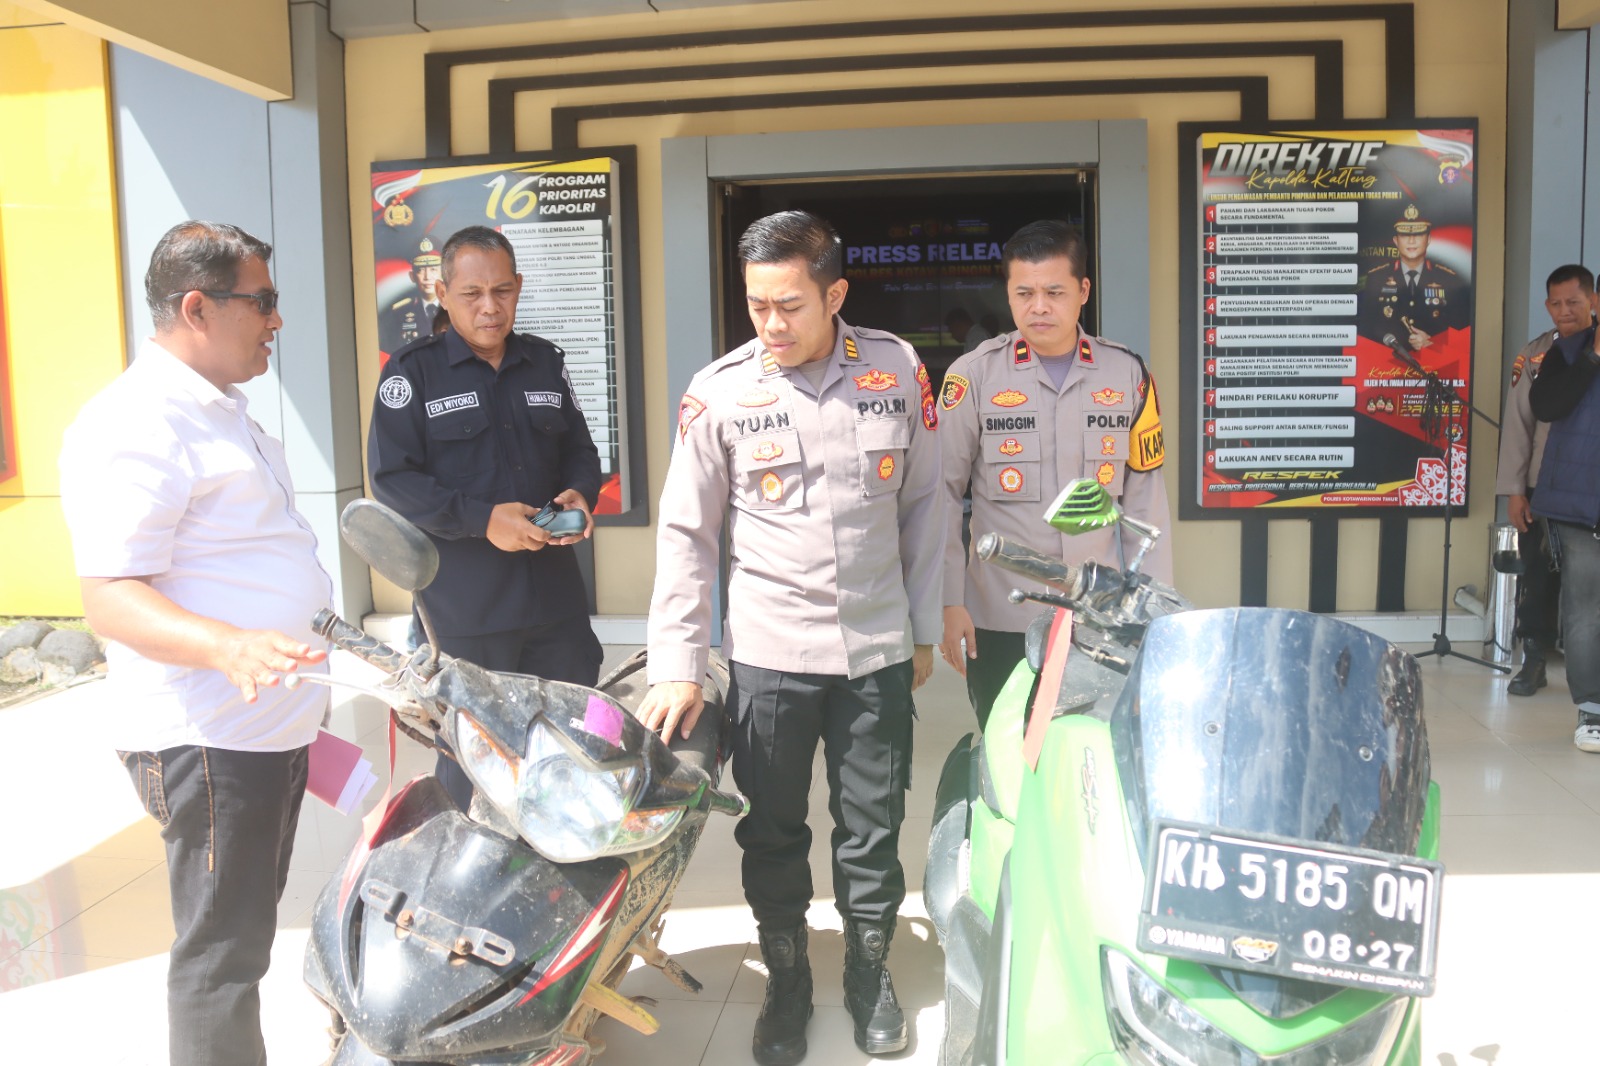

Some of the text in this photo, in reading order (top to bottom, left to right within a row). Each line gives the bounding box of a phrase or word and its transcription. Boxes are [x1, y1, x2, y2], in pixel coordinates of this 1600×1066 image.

[1208, 142, 1383, 176] DIREKTIF
[538, 174, 606, 188] PROGRAM
[1246, 168, 1309, 191] Kapolda
[482, 172, 545, 220] 16
[538, 188, 606, 201] PRIORITAS
[539, 202, 596, 216] KAPOLRI
[846, 244, 922, 264] PRESS
[430, 395, 475, 414] EDI WIYOKO
[857, 398, 906, 416] POLRI
[734, 411, 790, 436] YUAN
[986, 416, 1036, 431] SINGGIH
[1087, 414, 1130, 428] POLRI
[1242, 470, 1344, 480] RESPEK
[1164, 839, 1222, 890] KH
[1238, 853, 1349, 911] 5185
[1166, 928, 1226, 956] YAMAHA
[1292, 961, 1425, 990] SEMAKIN DI DEPAN
